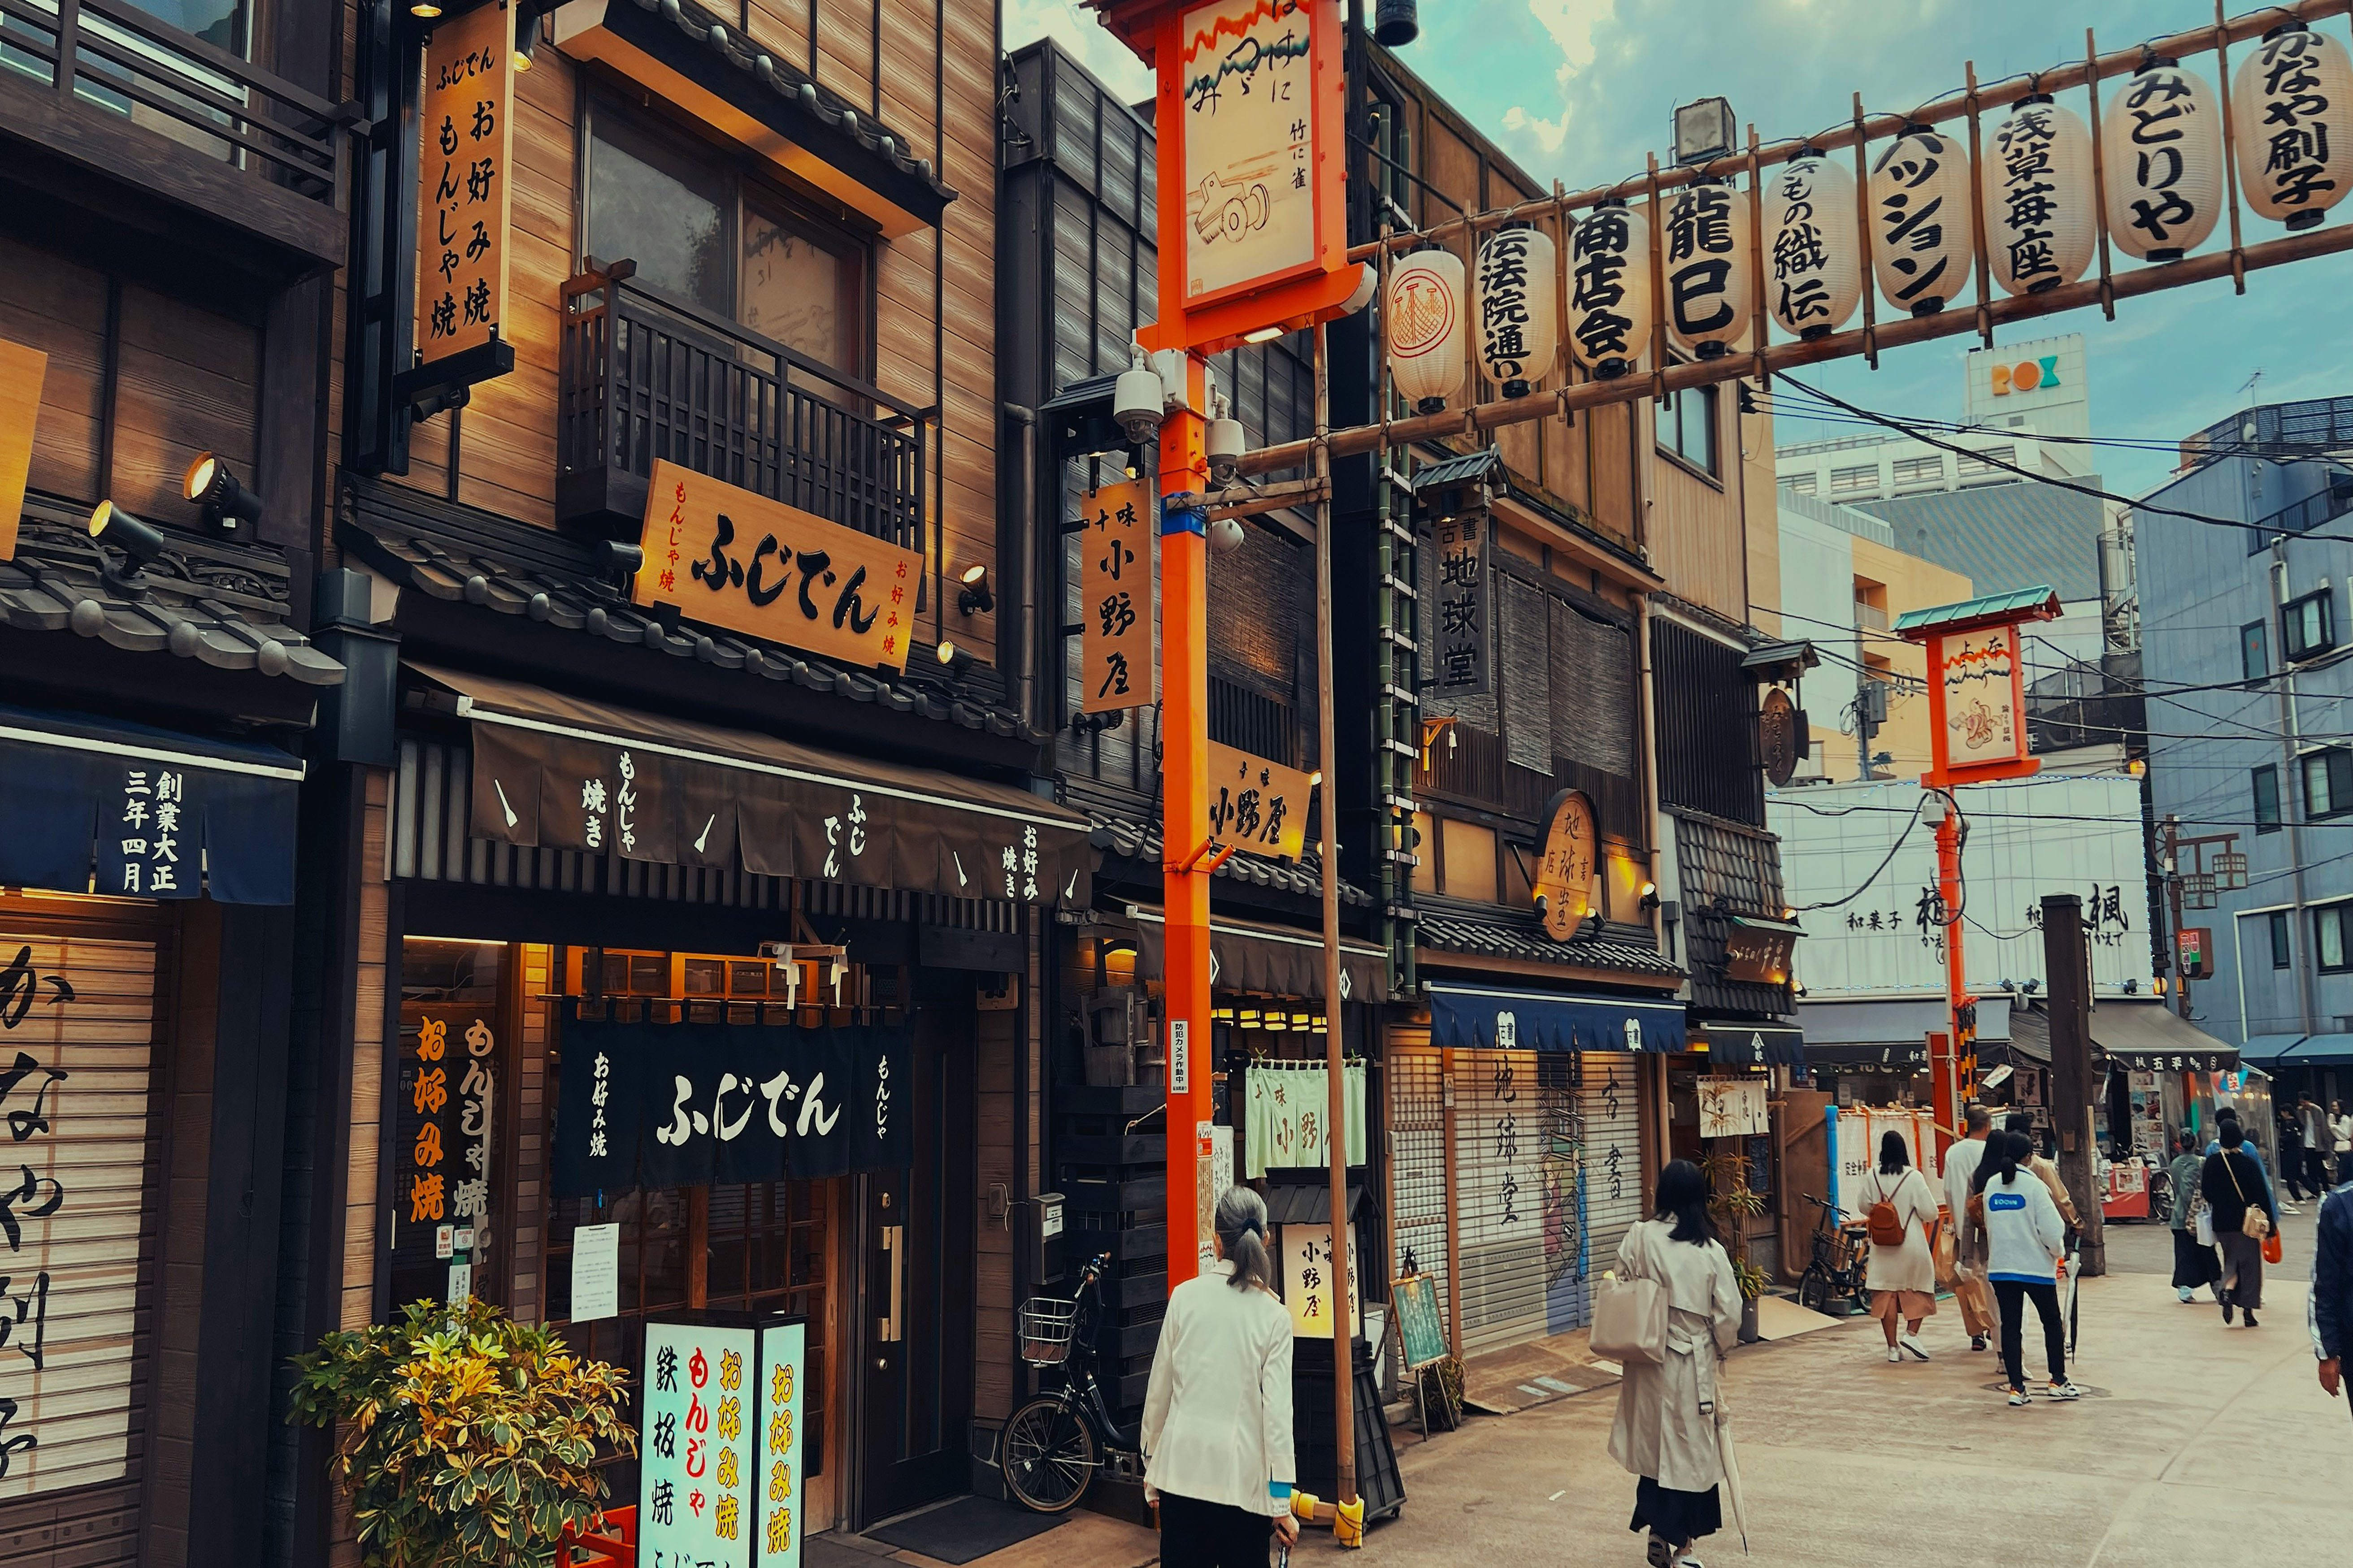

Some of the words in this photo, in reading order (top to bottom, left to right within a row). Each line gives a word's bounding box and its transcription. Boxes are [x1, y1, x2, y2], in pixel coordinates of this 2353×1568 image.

[436, 45, 495, 91] ふじでん
[2261, 32, 2336, 204] かなや刷子
[1290, 119, 1307, 190] 竹に雀
[2126, 73, 2195, 240] みどりや
[430, 115, 462, 340] もんじゃ焼
[463, 100, 495, 327] お好み焼
[1479, 230, 1531, 378] 伝法院通り
[1572, 209, 1632, 358] 商店会
[1991, 355, 2061, 396] ROX
[658, 482, 686, 592] もんじゃ焼
[1094, 502, 1138, 532] 十味
[1438, 515, 1479, 544] 古書
[691, 513, 880, 634] ふじでん
[881, 560, 907, 655] お好み焼
[1098, 539, 1136, 698] 小野屋
[1441, 547, 1479, 687] 地球堂
[122, 771, 152, 893] 三年四月
[150, 771, 183, 891] 創業大正
[582, 778, 607, 848] 焼き
[617, 751, 636, 852] もんじゃ
[824, 816, 840, 879] でん
[848, 794, 867, 856] ふじ
[1210, 786, 1287, 844] 小野屋
[1002, 845, 1018, 898] 焼き
[1022, 825, 1039, 901] お好み
[2088, 883, 2128, 931] 楓
[1847, 910, 1902, 931] 和菓子
[876, 1055, 890, 1139] もんじゃ
[1175, 1023, 1183, 1083] 防犯カメラ作動中
[411, 1015, 447, 1222] お好み焼
[589, 1051, 609, 1157] お好み焼
[656, 1070, 842, 1146] ふじでん
[1276, 1112, 1330, 1154] 小野
[1494, 1054, 1520, 1226] 地球堂
[1302, 1242, 1321, 1317] 小野屋
[652, 1345, 678, 1526] 鉄板焼
[686, 1347, 708, 1518] もんじゃ
[716, 1348, 742, 1540] お好み焼
[767, 1364, 794, 1554] お好み焼
